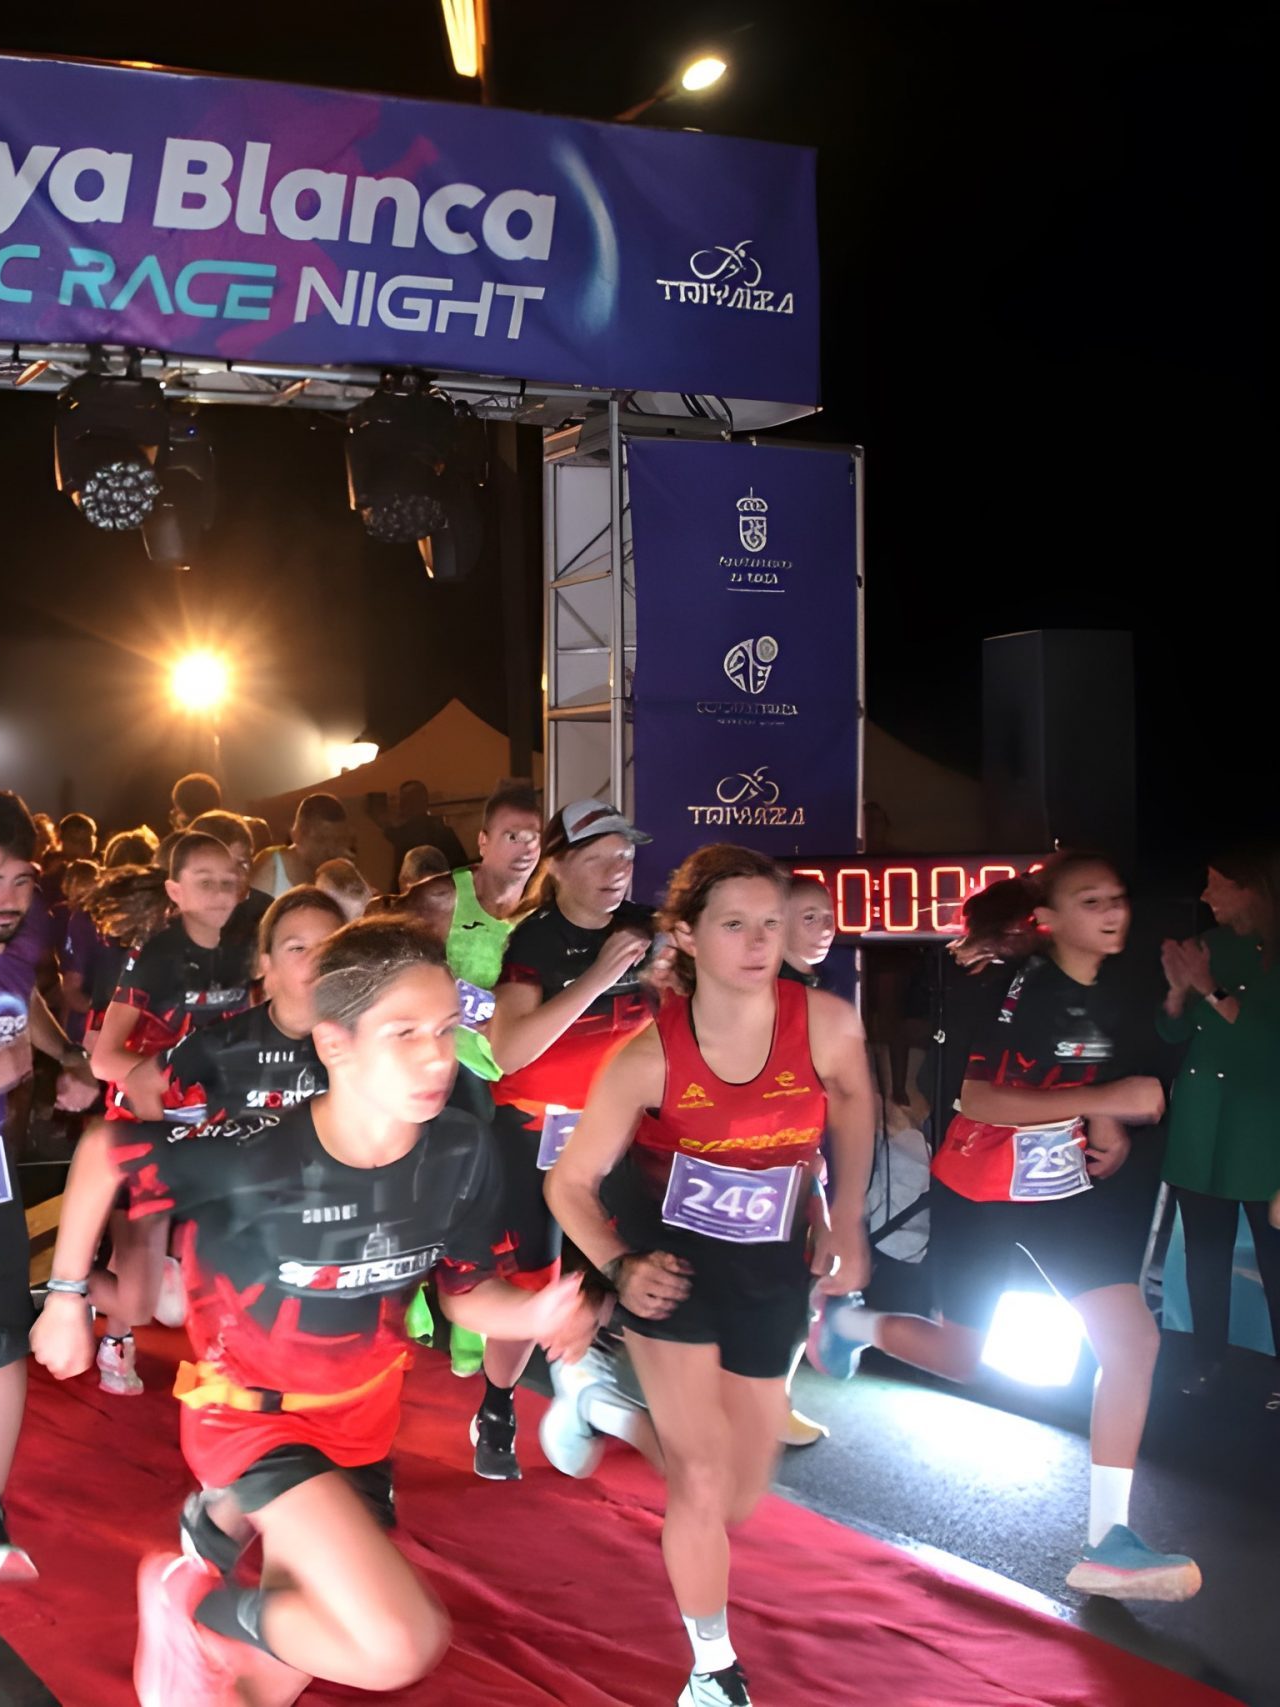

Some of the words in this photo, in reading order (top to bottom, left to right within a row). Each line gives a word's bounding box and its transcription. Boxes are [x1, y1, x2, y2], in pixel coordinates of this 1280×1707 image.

[153, 137, 556, 261] Blanca
[59, 247, 276, 320] RACE
[293, 266, 546, 340] NIGHT
[682, 1177, 779, 1222] 246
